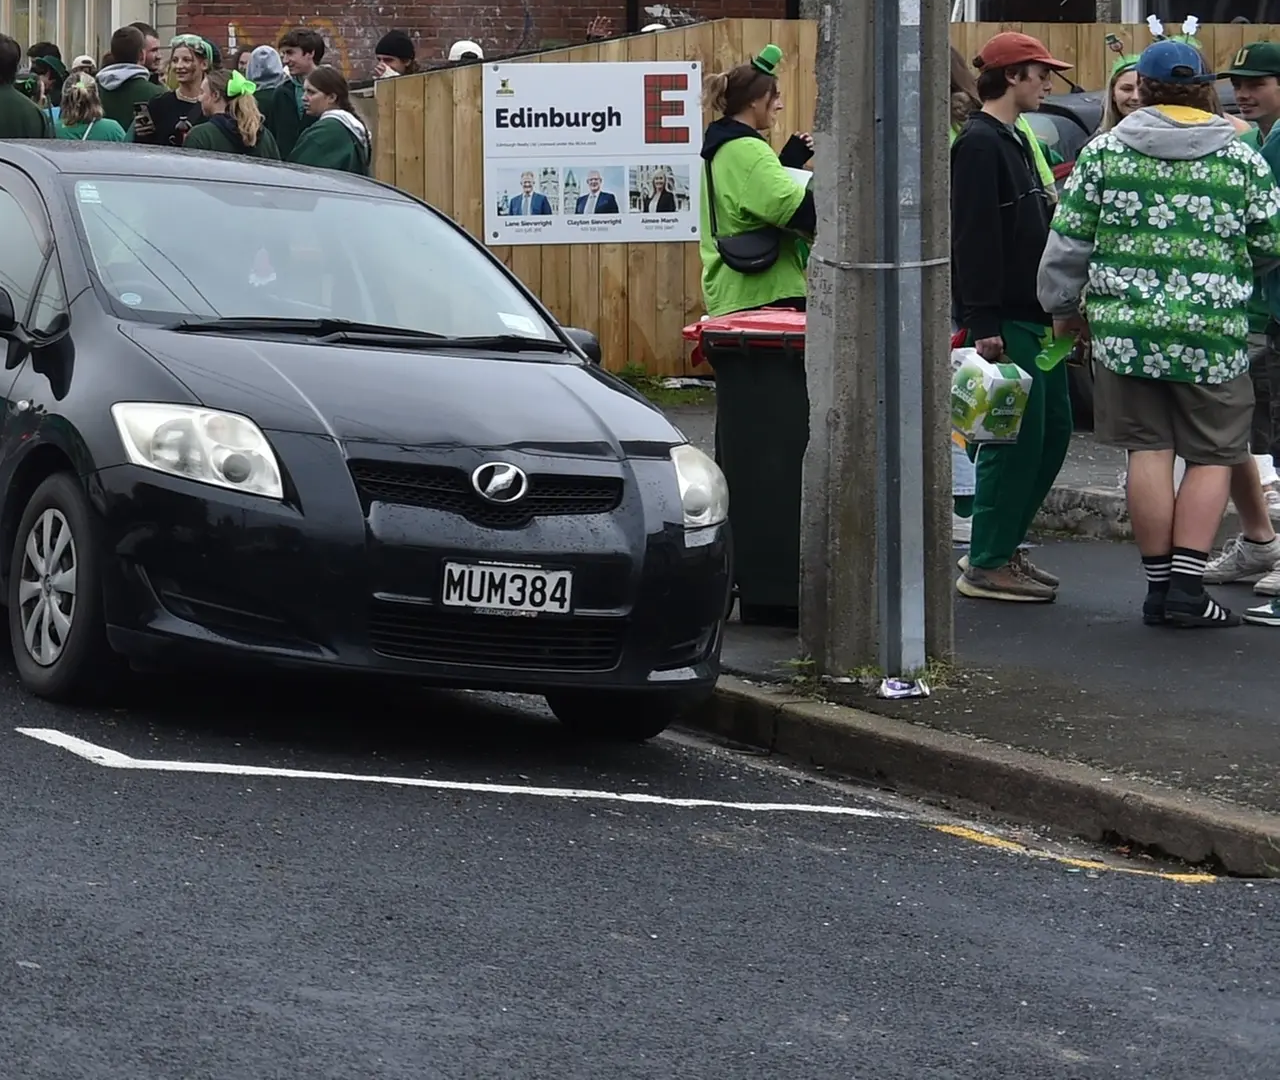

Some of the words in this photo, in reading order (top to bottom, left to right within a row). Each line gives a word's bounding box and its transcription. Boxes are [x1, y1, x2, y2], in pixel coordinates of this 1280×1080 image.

[495, 106, 621, 132] Edinburgh
[644, 74, 689, 144] E
[567, 219, 589, 227] Clayton
[445, 568, 567, 609] MUM384
